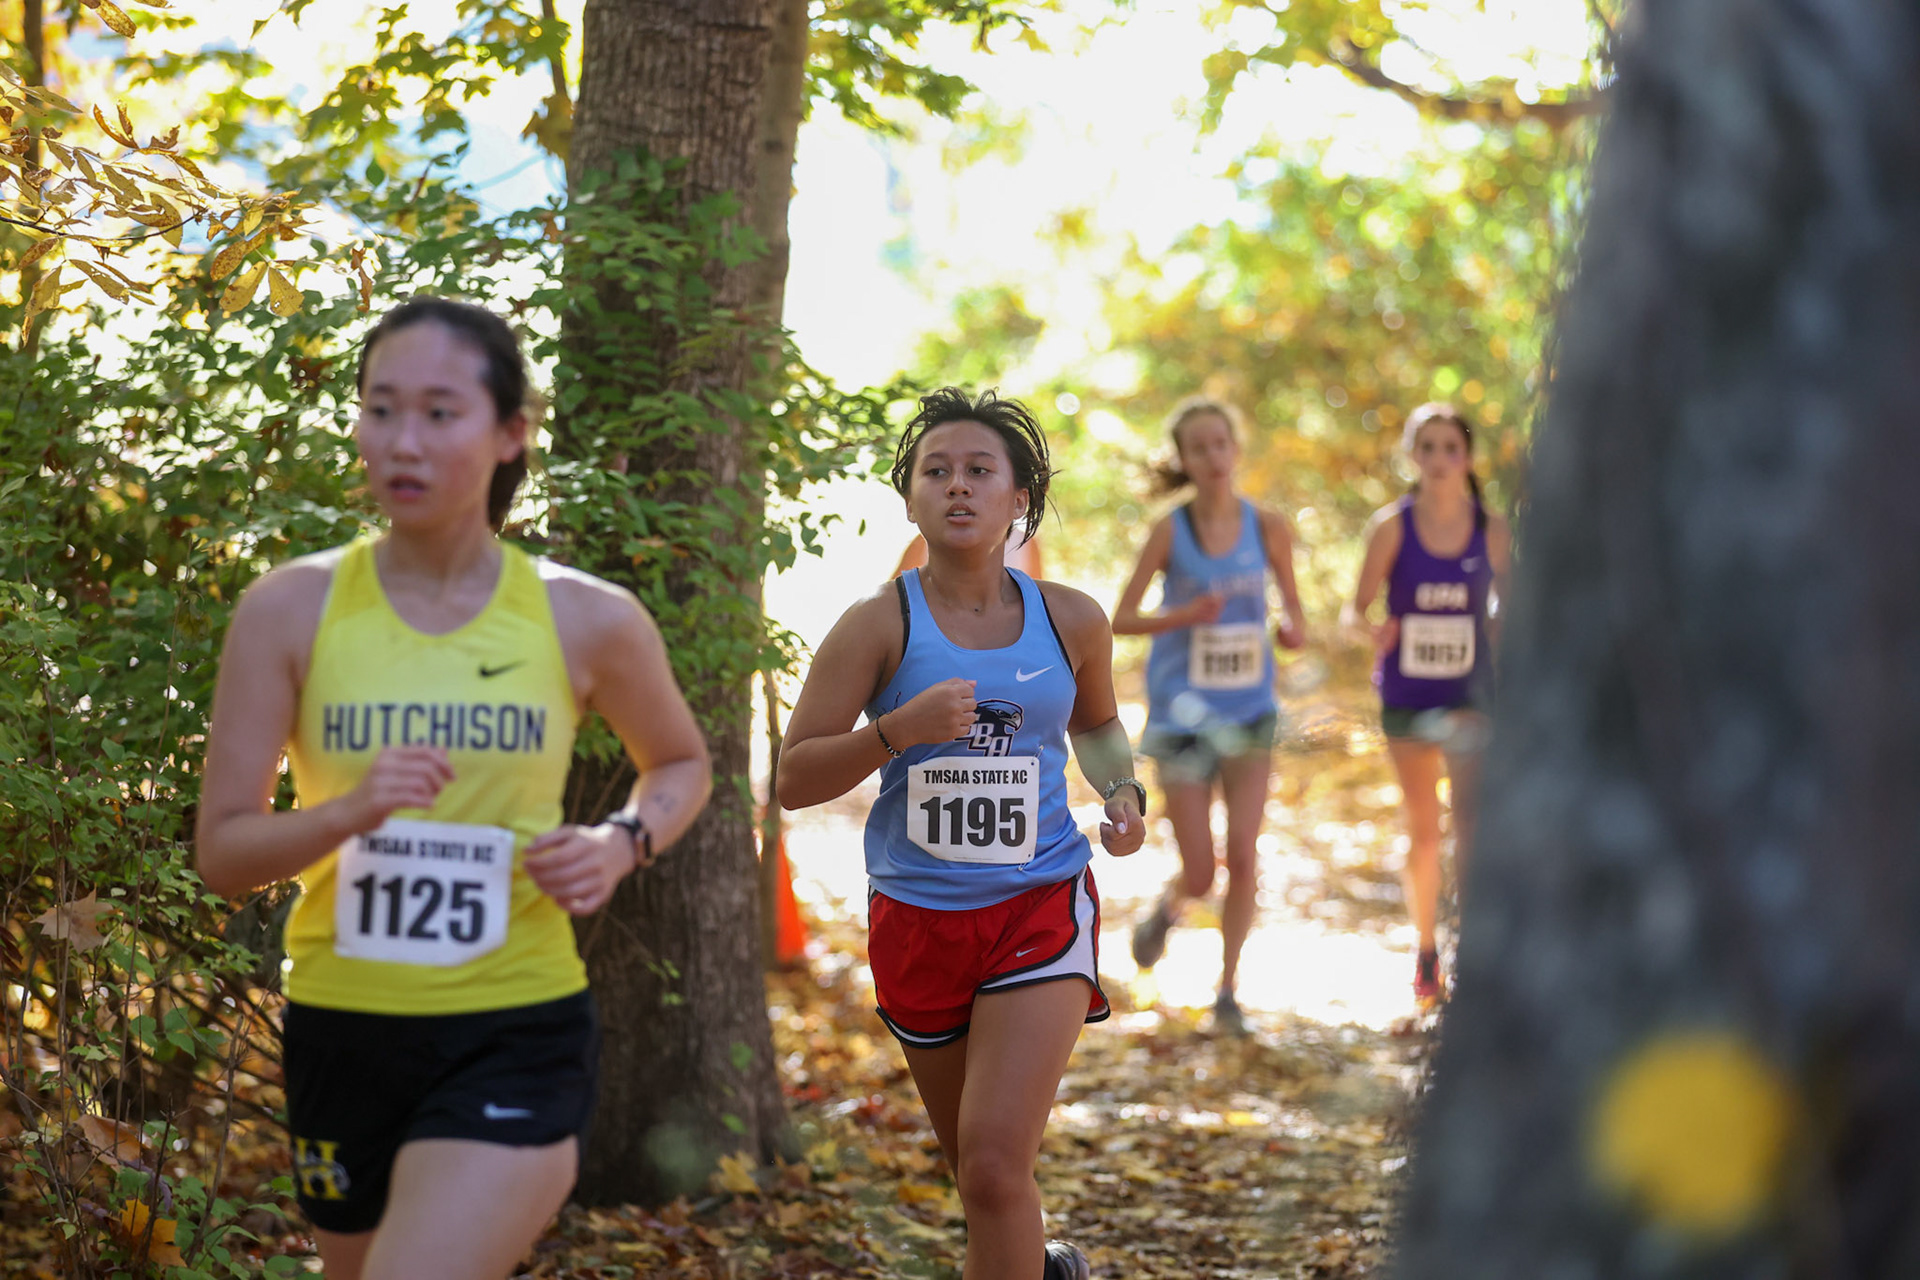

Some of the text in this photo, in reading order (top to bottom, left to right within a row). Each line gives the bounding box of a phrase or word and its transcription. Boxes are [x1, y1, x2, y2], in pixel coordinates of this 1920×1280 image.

[323, 702, 546, 753] HUTCHISON
[923, 769, 1028, 785] TMSAA STATE XC
[920, 796, 1027, 847] 1195
[353, 871, 485, 944] 1125
